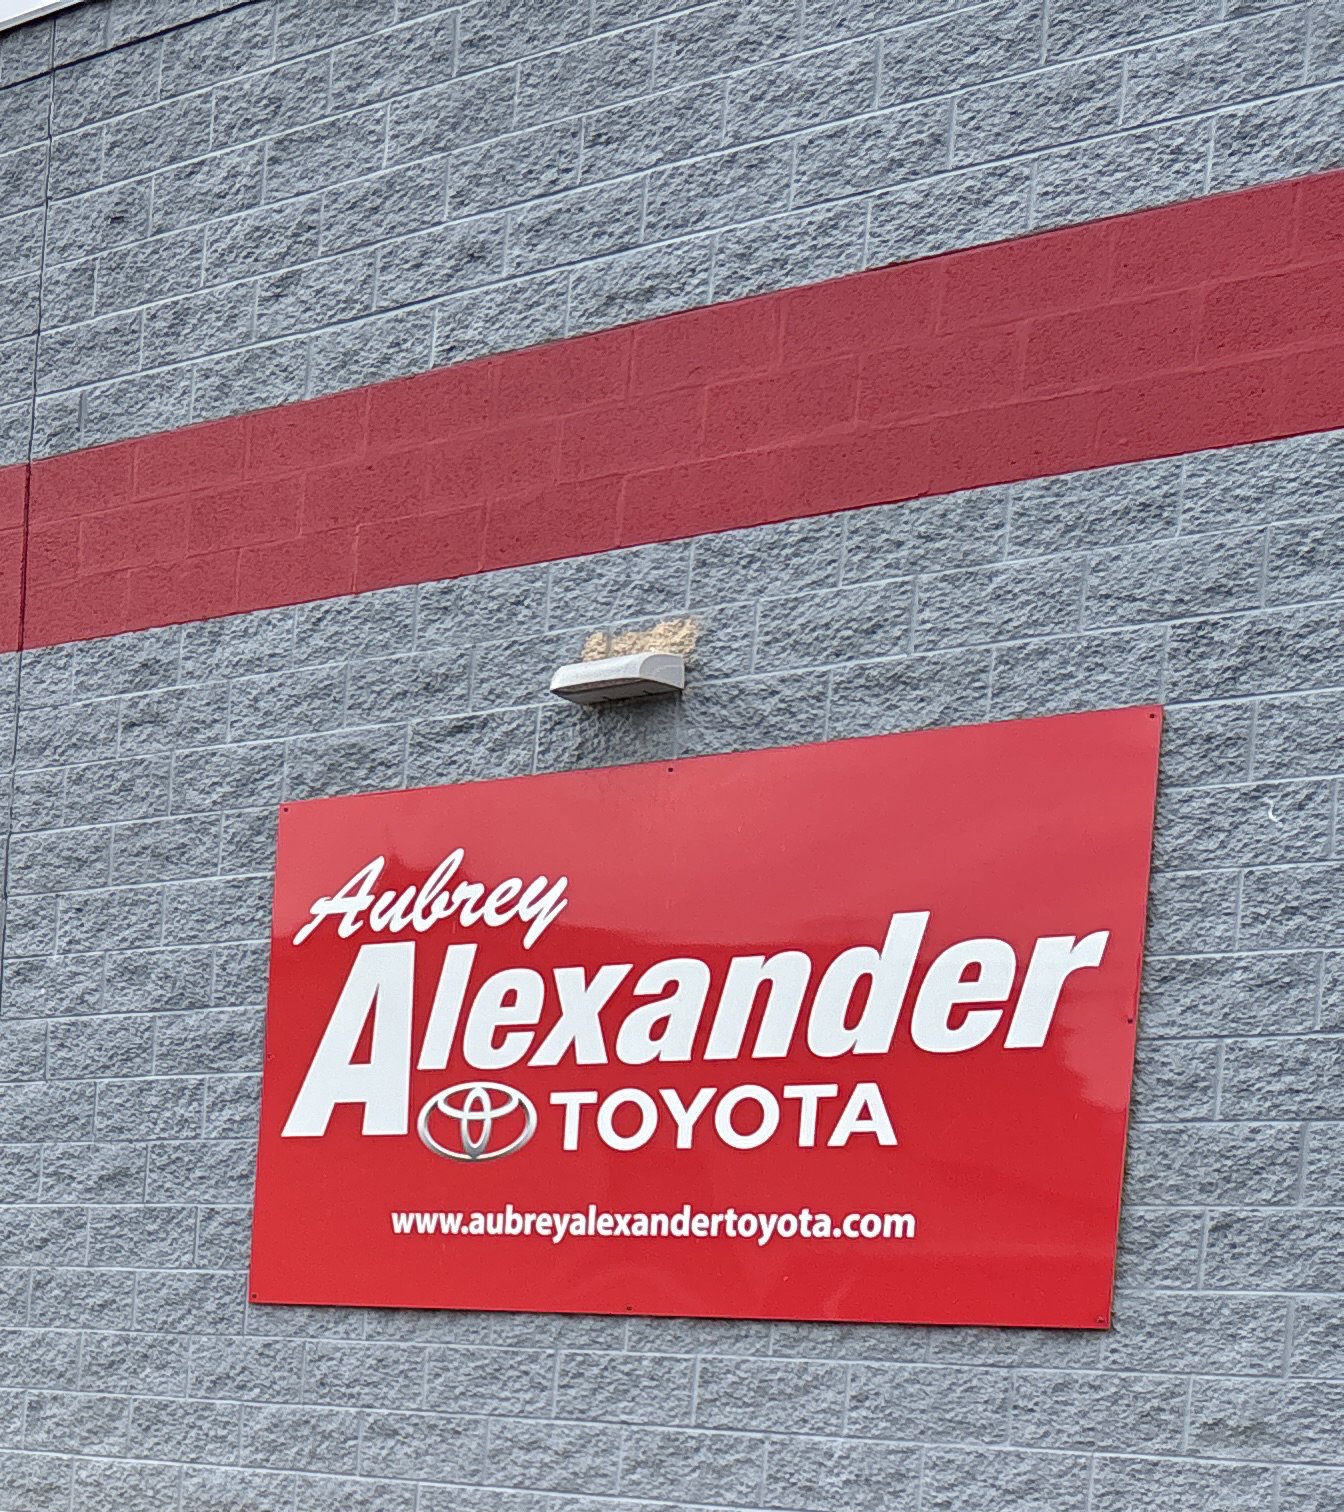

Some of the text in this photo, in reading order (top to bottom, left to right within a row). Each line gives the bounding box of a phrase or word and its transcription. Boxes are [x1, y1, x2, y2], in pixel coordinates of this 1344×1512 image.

[293, 848, 568, 949] Aubrey
[280, 910, 1110, 1137] Alexander
[549, 1082, 898, 1151] TOYOTA
[391, 1204, 916, 1246] www.aubreyalexandertoyota.com
